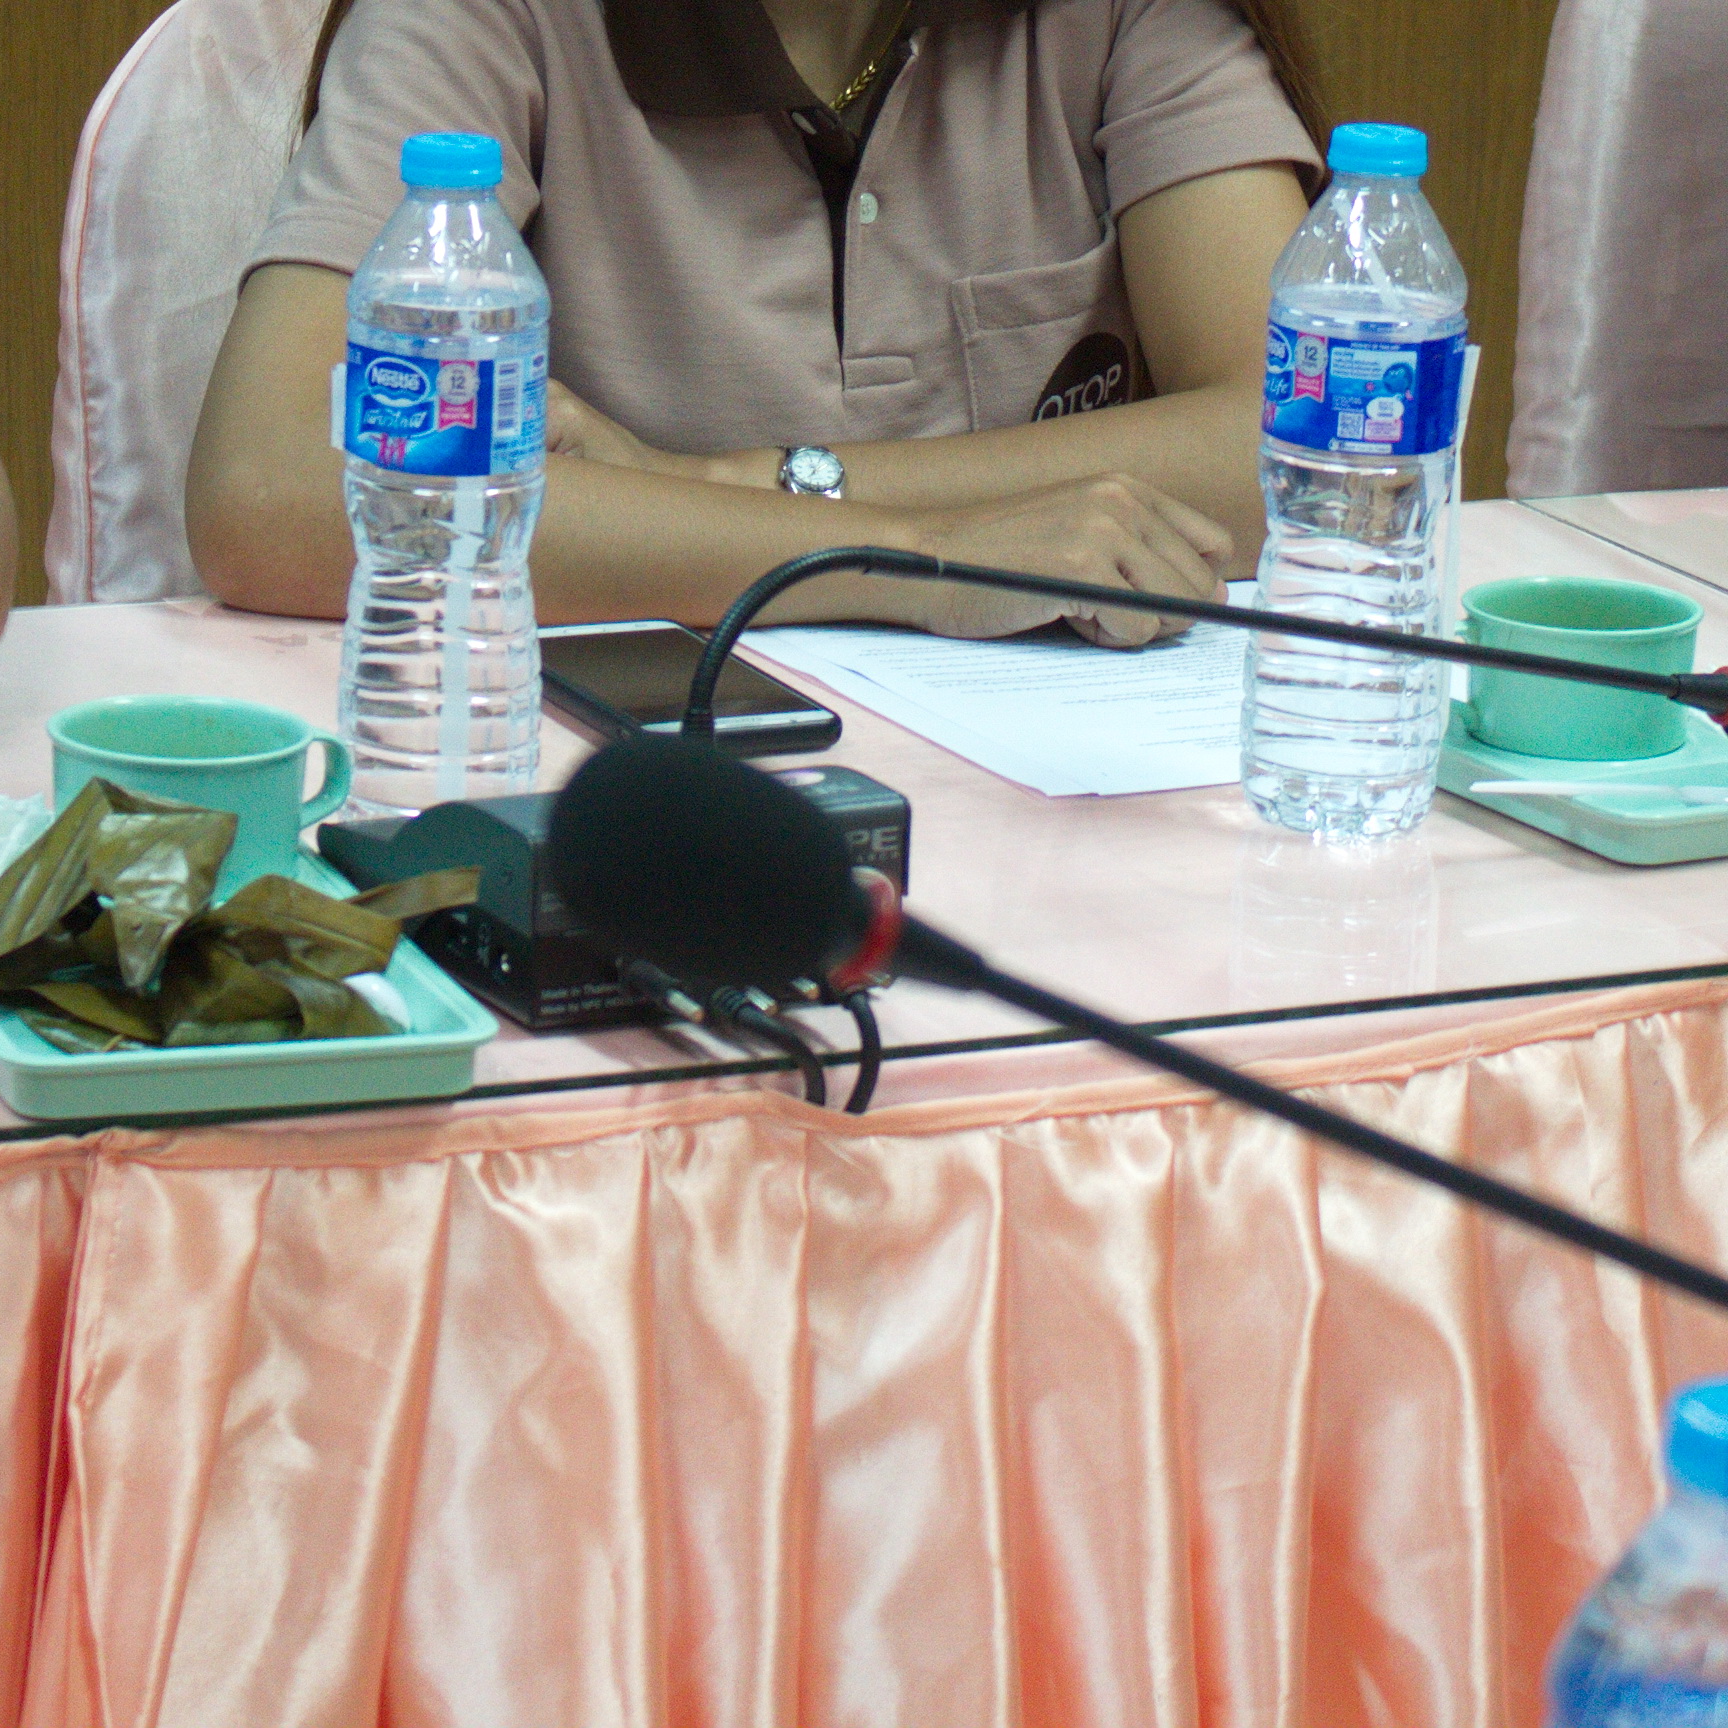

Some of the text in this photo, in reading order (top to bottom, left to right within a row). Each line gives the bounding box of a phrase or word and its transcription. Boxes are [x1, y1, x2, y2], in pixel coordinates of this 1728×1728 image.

[1304, 345, 1318, 361] 12
[451, 375, 466, 390] 12
[1037, 363, 1122, 422] OTOP
